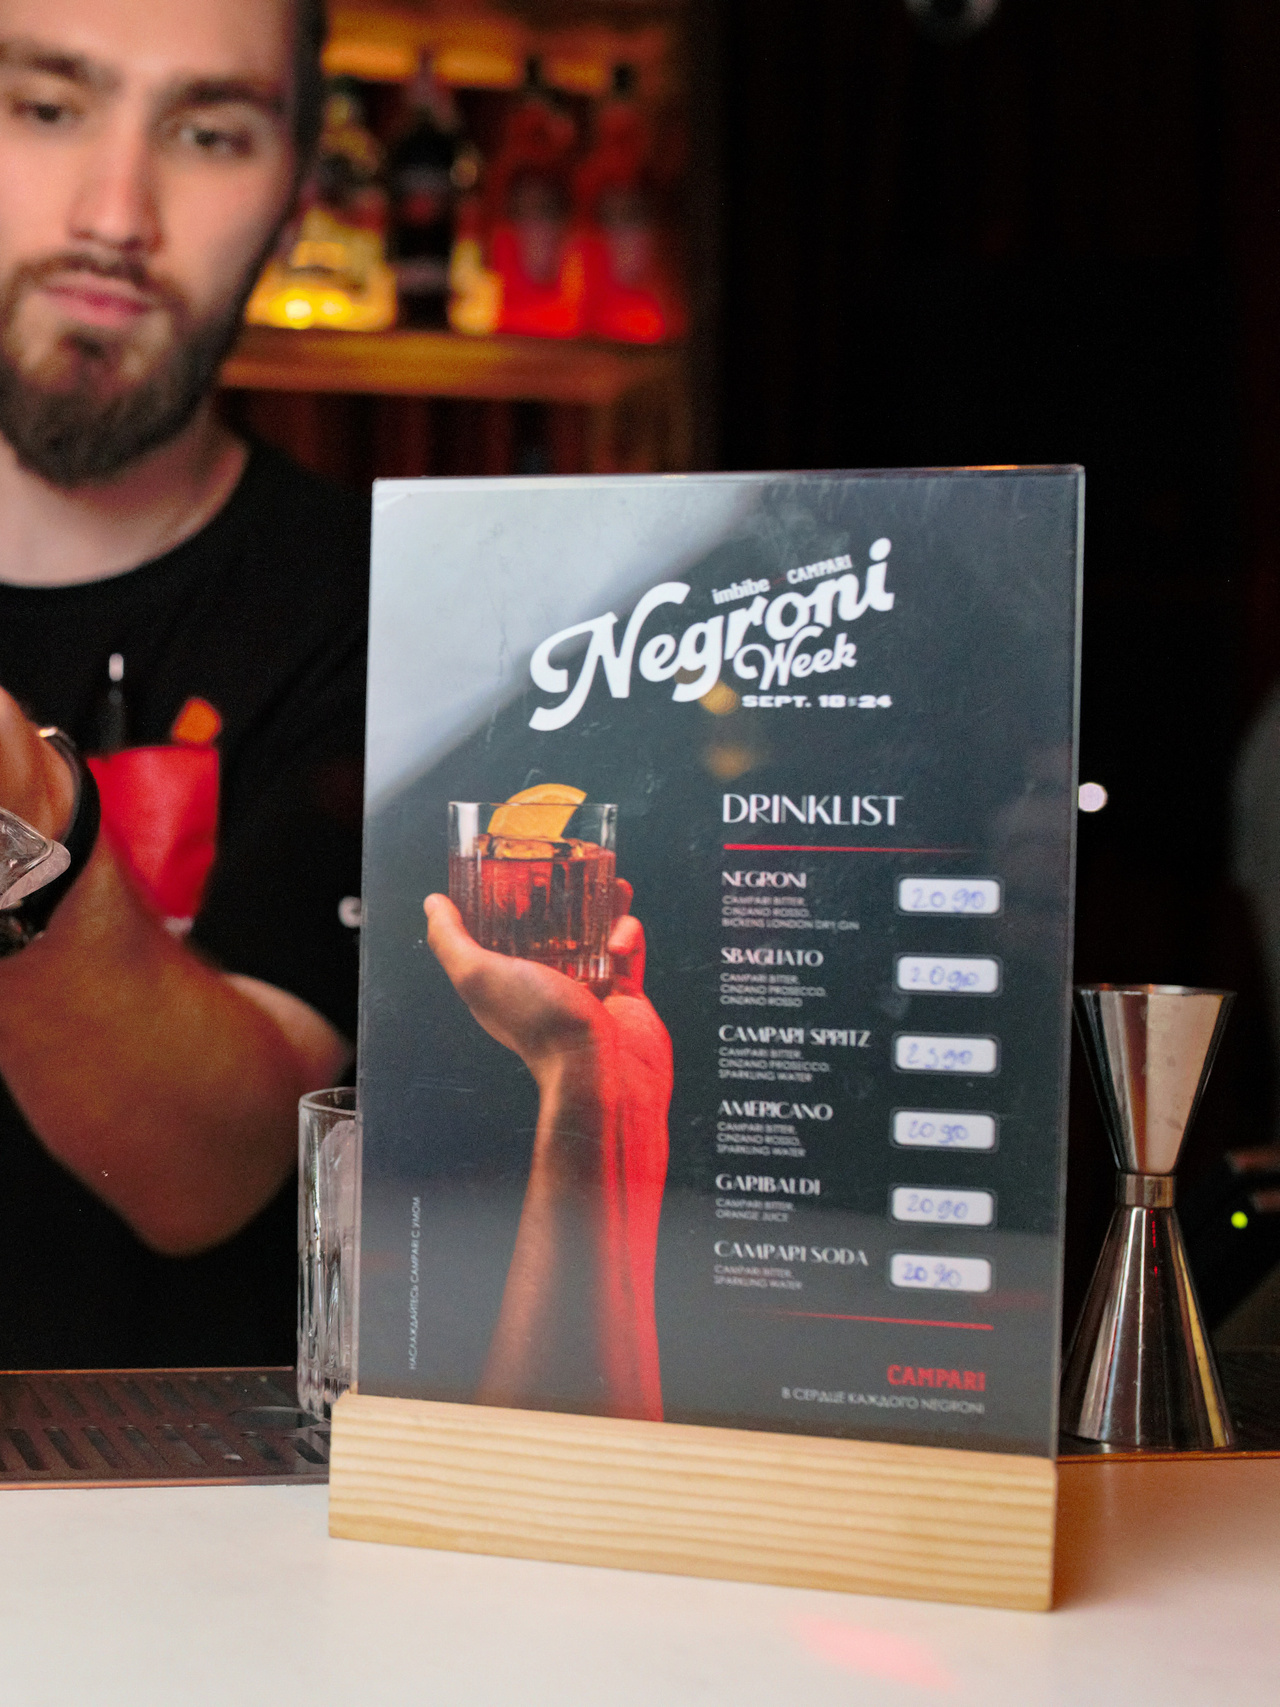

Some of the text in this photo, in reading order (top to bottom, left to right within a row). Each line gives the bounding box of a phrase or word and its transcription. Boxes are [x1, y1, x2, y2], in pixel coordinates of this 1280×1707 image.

[711, 554, 853, 605] imbibe CAMPARI
[528, 537, 895, 732] Negroni
[733, 625, 858, 691] Week
[741, 694, 812, 709] SEPT.
[721, 793, 904, 826] DRINKLIST
[720, 947, 824, 967] SBAGLIATO
[718, 1100, 833, 1121] AMERICANO
[810, 1246, 869, 1266] SODA
[886, 1364, 986, 1392] CAMPARI
